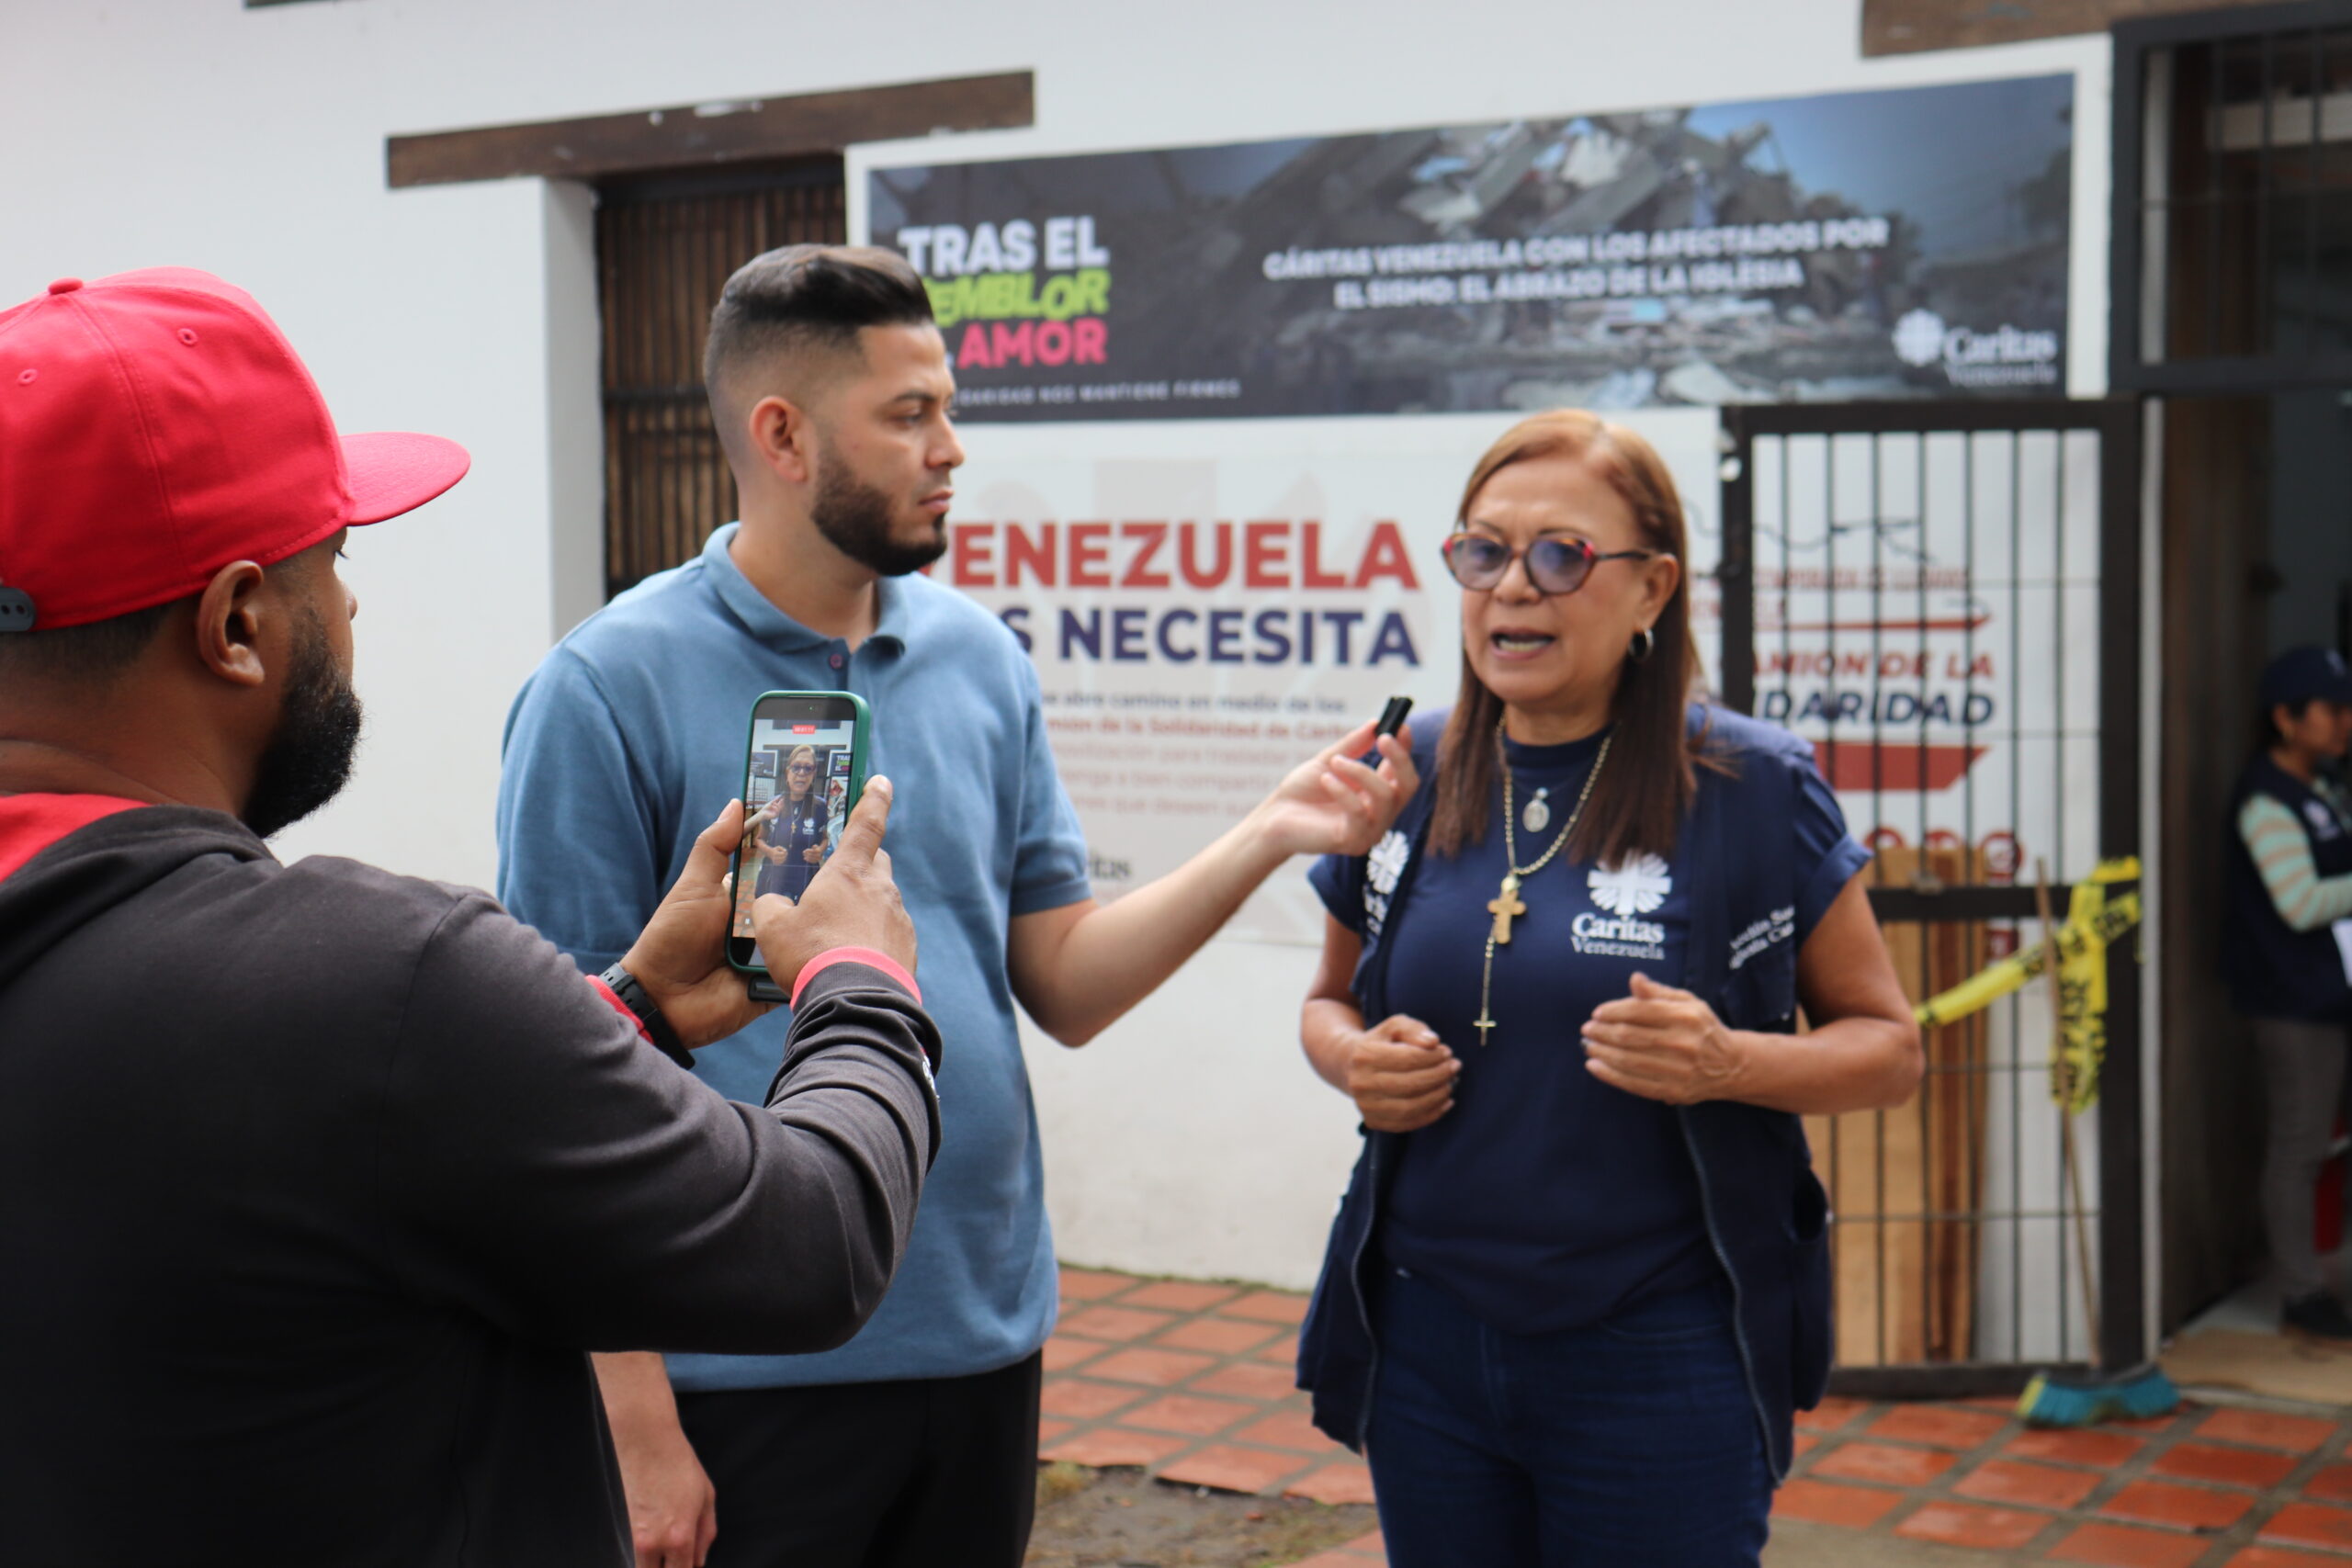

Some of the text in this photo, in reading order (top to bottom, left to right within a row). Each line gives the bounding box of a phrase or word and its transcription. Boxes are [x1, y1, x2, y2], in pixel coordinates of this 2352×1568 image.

[898, 216, 1110, 275] TRAS EL
[1374, 240, 1522, 274] VENEZUELA
[1524, 235, 1589, 266] CON
[1591, 231, 1646, 262] LOS
[1647, 220, 1820, 260] AFECTADOS
[1822, 217, 1890, 249] POR
[1334, 280, 1364, 310] EL
[1459, 274, 1490, 303] EL
[1492, 266, 1606, 301] ABRAZO
[1609, 265, 1646, 298] DE
[1650, 263, 1688, 294] LA
[1690, 257, 1804, 291] IGLESIA
[957, 318, 1109, 369] AMOR
[1944, 324, 2057, 365] Caritas
[922, 522, 1420, 591] ENEZUELA
[1059, 607, 1421, 668] NECESITA
[1946, 650, 1994, 680] LA
[1753, 690, 1994, 726] DARIDAD
[1570, 935, 1666, 961] Venezuela
[1571, 912, 1666, 944] Caritas
